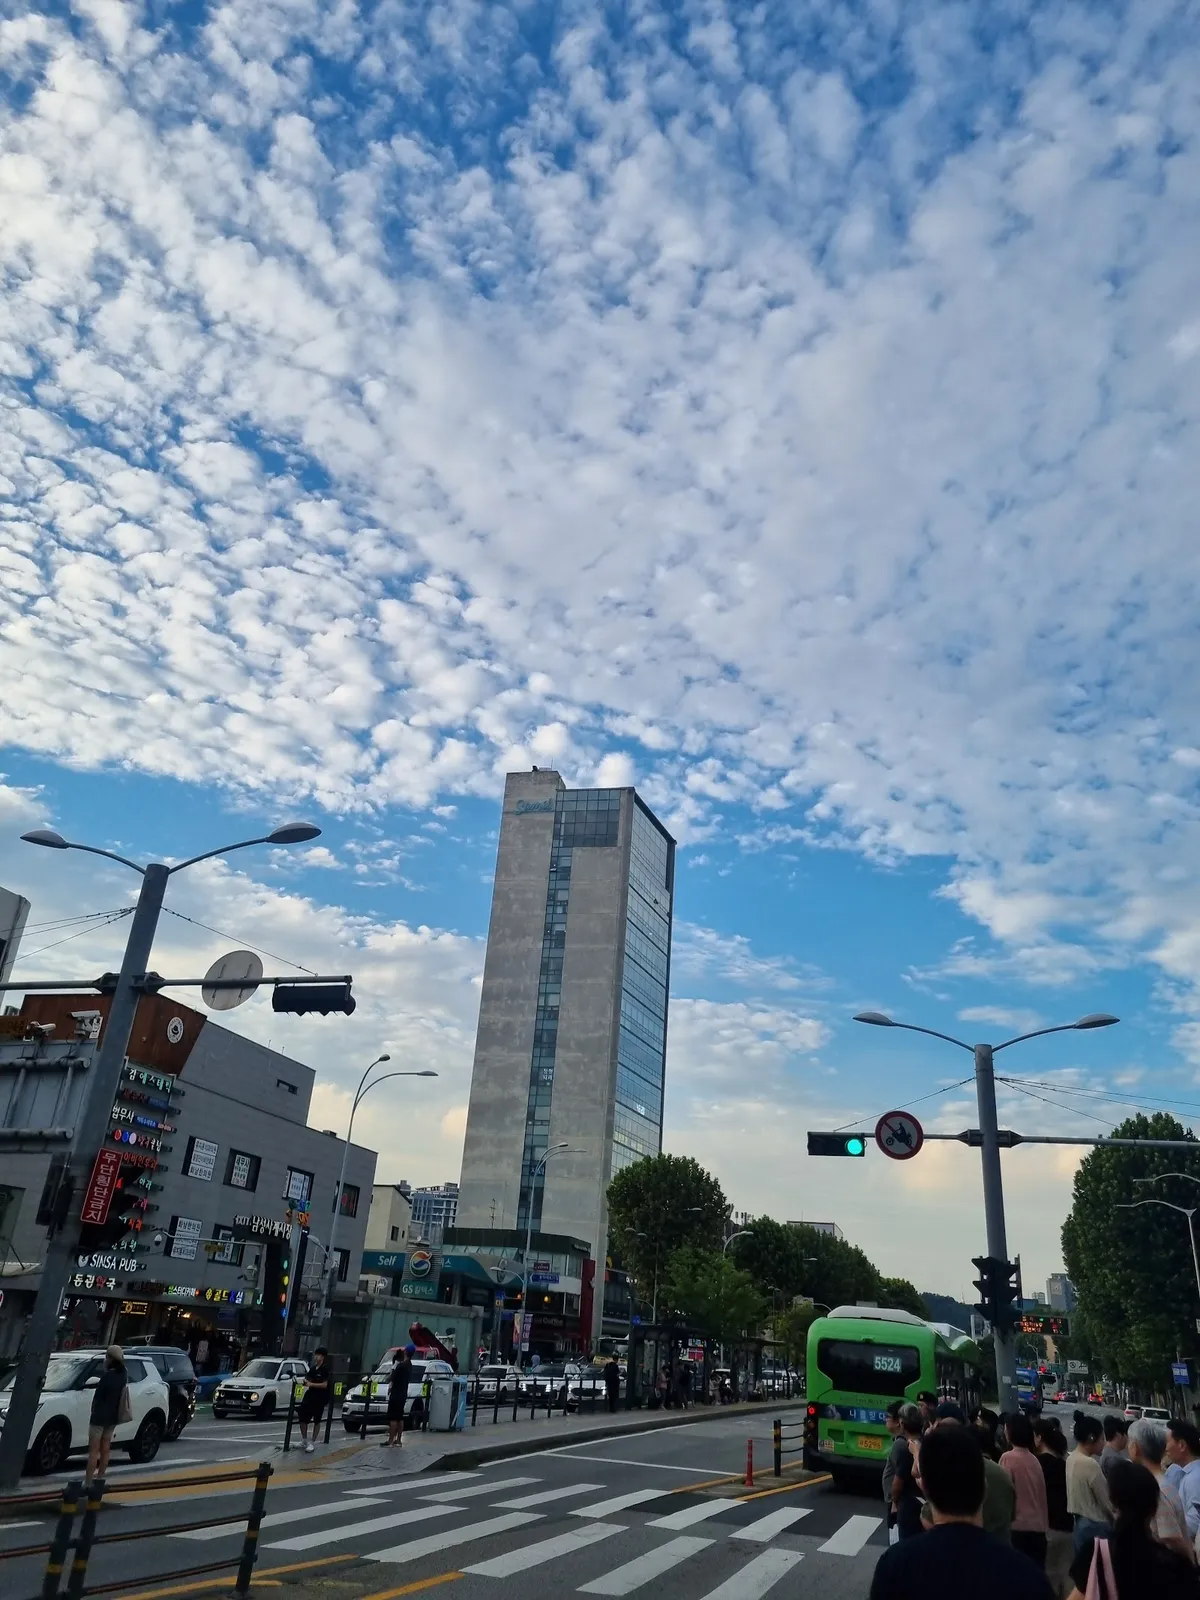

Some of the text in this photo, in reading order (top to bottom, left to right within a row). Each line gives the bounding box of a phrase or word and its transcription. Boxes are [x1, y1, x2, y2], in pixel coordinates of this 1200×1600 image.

[112, 1104, 135, 1123] 법무사
[86, 1152, 117, 1221] 무단횡단금지
[90, 1254, 137, 1272] SINSA PUB
[378, 1255, 398, 1266] Self
[73, 1273, 117, 1290] 동광약국
[873, 1356, 901, 1372] 5524
